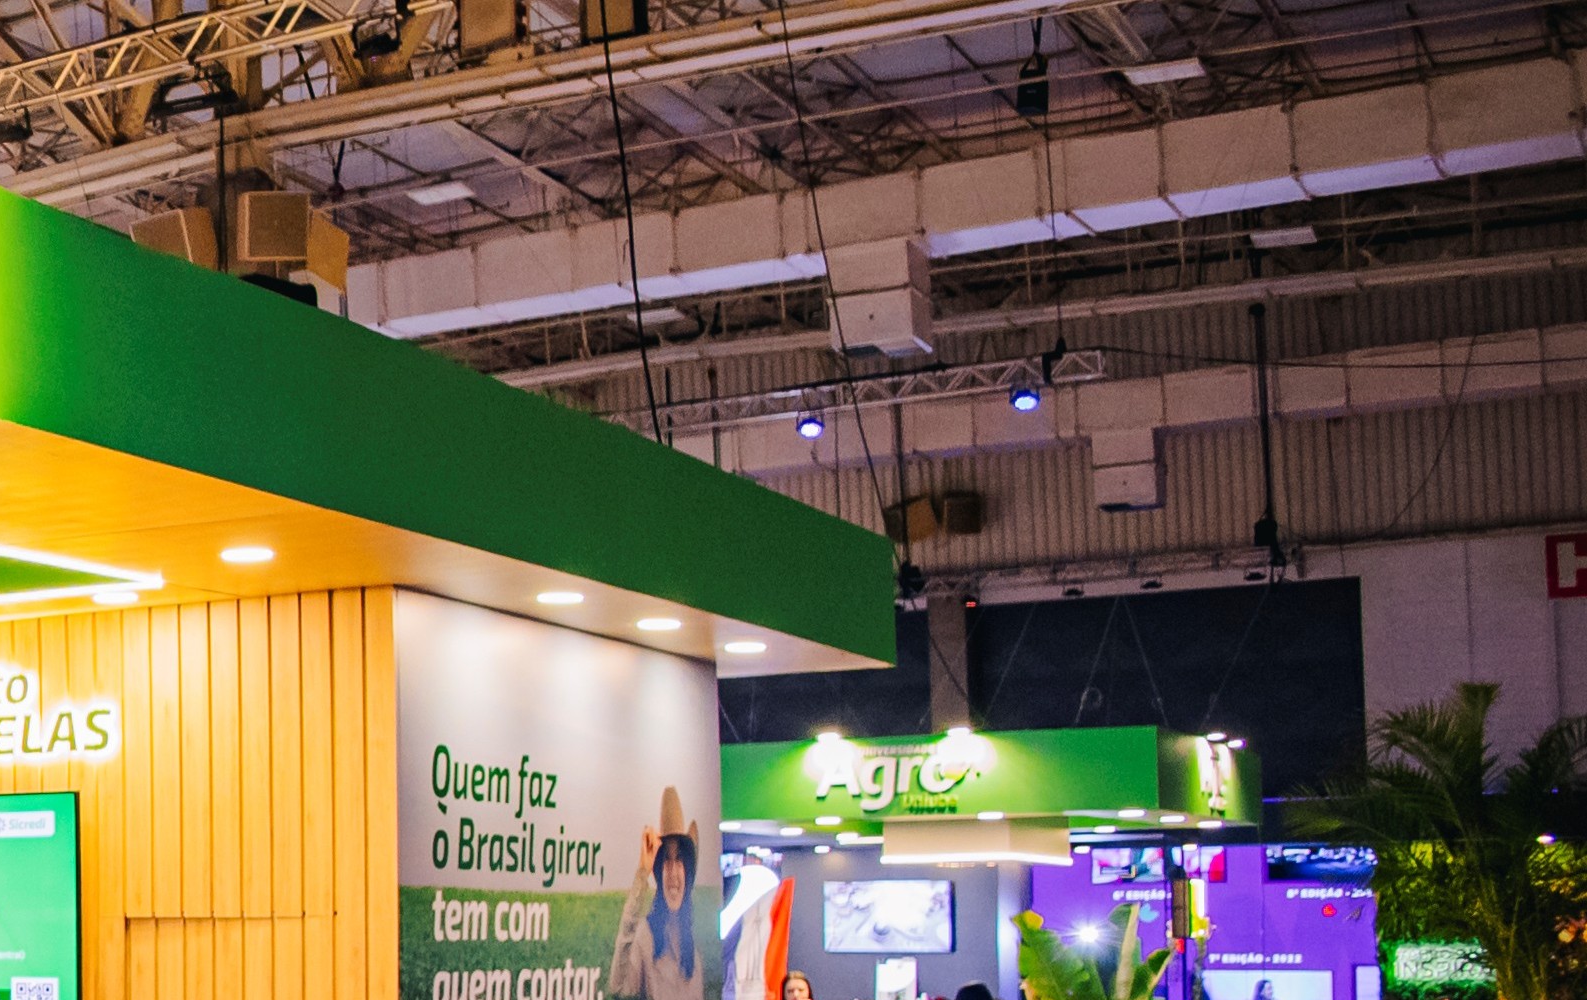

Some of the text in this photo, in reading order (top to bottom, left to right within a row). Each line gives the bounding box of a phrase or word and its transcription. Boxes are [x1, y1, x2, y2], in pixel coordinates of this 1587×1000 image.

[432, 744, 558, 819] Quem faz
[432, 817, 604, 888] o Brasil girar,
[432, 889, 550, 942] tem com
